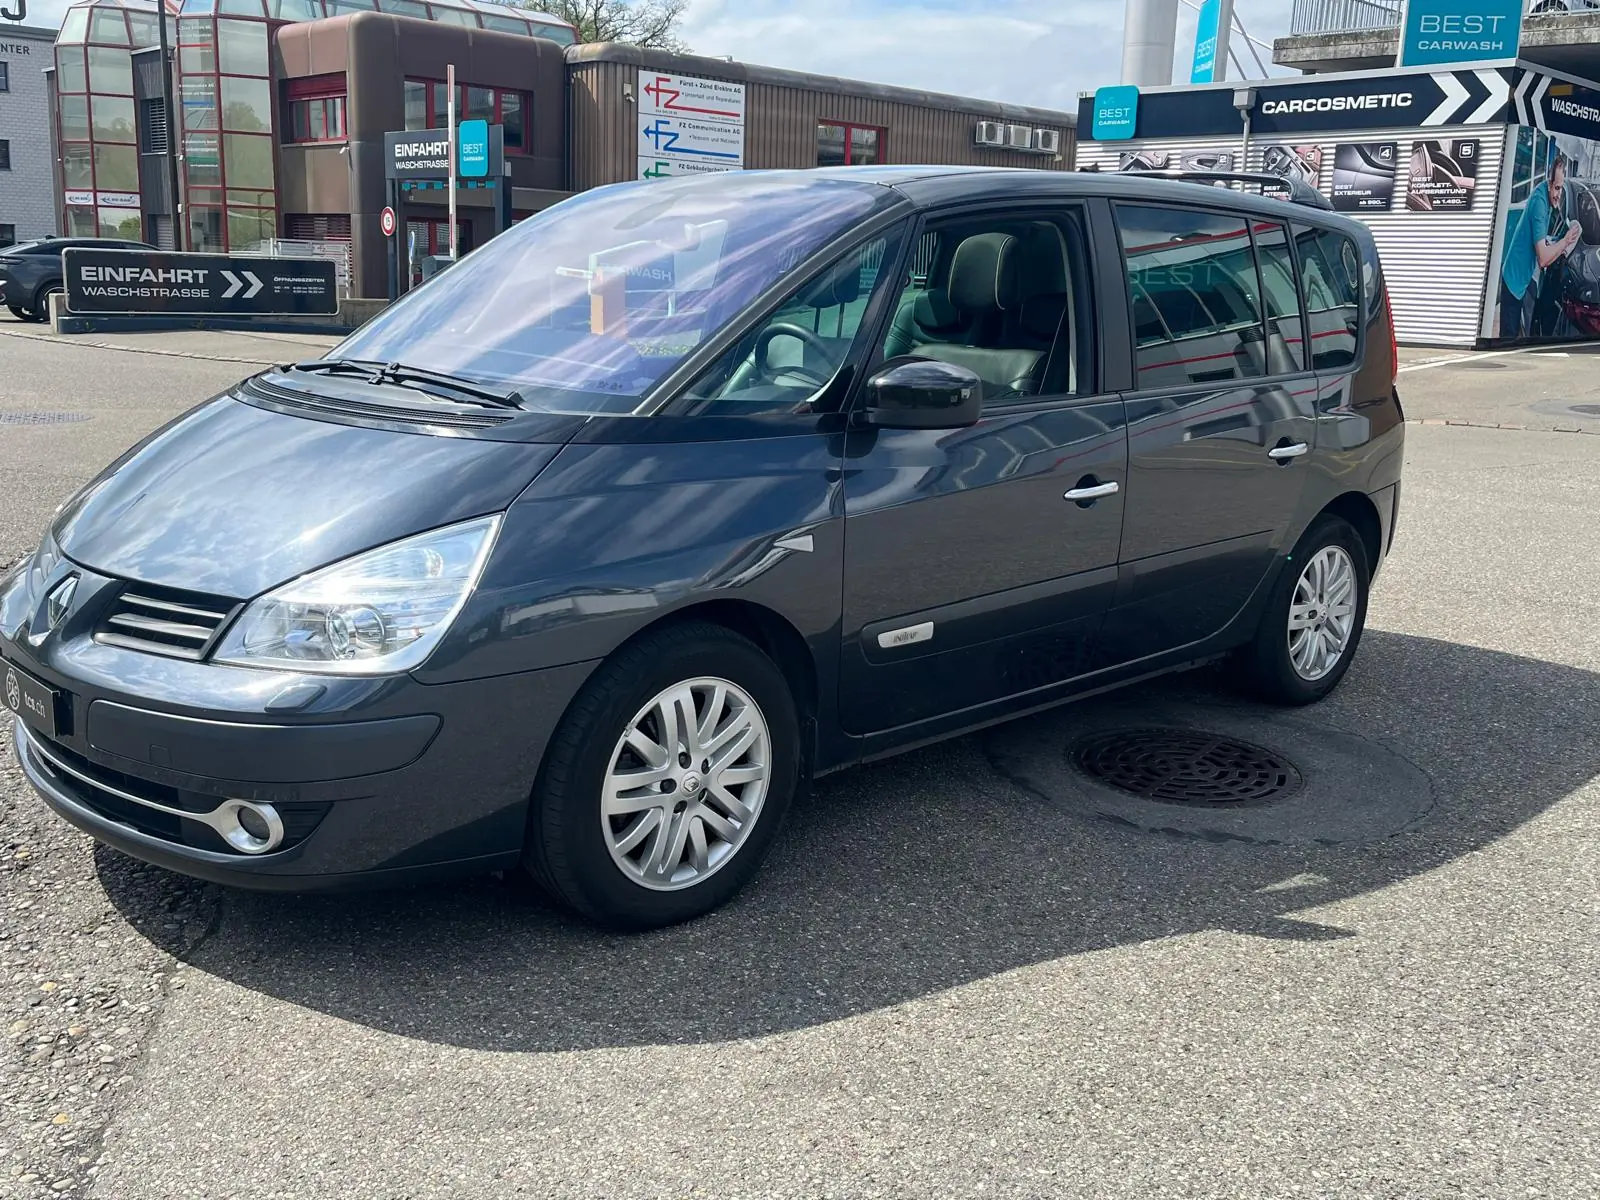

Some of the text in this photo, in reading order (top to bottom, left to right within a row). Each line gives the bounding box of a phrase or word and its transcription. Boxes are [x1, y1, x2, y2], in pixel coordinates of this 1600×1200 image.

[1420, 15, 1506, 34] BEST
[1418, 40, 1503, 50] CARWASH
[1262, 92, 1413, 115] CARCOSMETIC
[1099, 107, 1130, 119] BEST
[394, 142, 449, 157] EINFAHRT
[462, 143, 483, 154] BEST
[1381, 149, 1390, 157] 4
[1461, 146, 1471, 155] 5
[1219, 155, 1227, 163] 2
[1306, 152, 1315, 161] 3
[395, 159, 449, 170] WASCHSTRASSE
[80, 266, 209, 284] EINFAHRT
[82, 286, 210, 298] WASCHSTRASSE
[24, 691, 46, 718] tcs.ch
